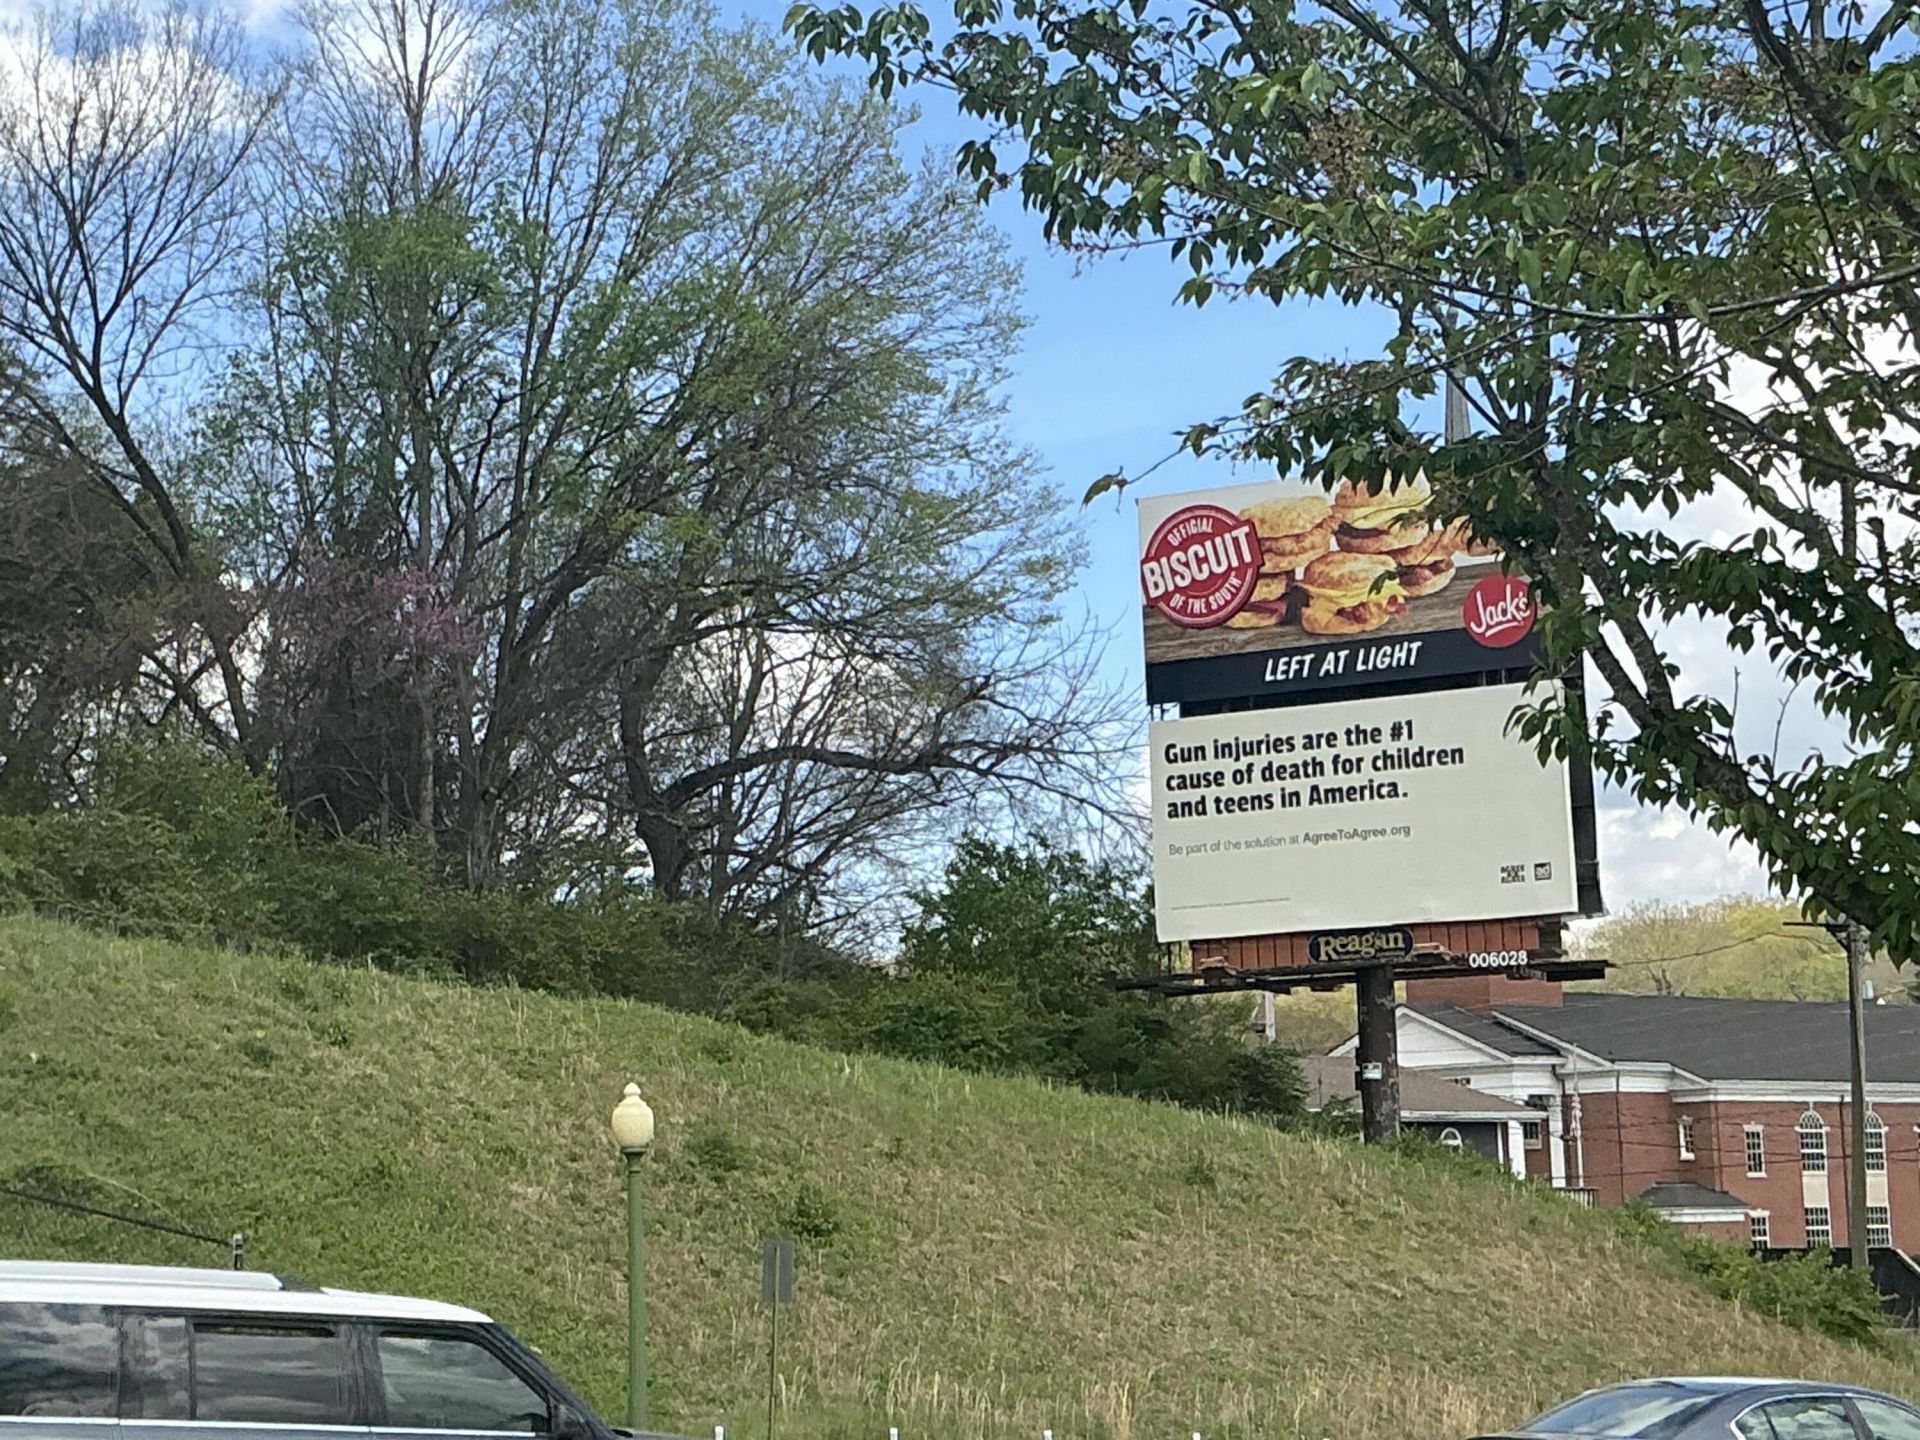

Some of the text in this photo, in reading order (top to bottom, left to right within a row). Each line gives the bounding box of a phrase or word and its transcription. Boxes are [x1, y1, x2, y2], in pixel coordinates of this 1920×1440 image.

[1167, 517, 1214, 546] OFFICIAL
[1142, 525, 1253, 599] BISCUIT
[1169, 570, 1242, 614] OF THE SOUTH
[1470, 584, 1531, 634] Jack's
[1265, 641, 1423, 682] LEFT AT LIGHT
[1164, 719, 1414, 765] Gun injuries are the #1
[1165, 745, 1465, 792] cause of death for children
[1166, 778, 1409, 820] and teens in America.
[1168, 843, 1184, 856] Be
[1185, 842, 1208, 857] part
[1209, 839, 1221, 853] of
[1223, 839, 1242, 852] the
[1244, 835, 1287, 850] solution
[1317, 930, 1405, 962] Reagan
[1468, 949, 1529, 968] 006028
